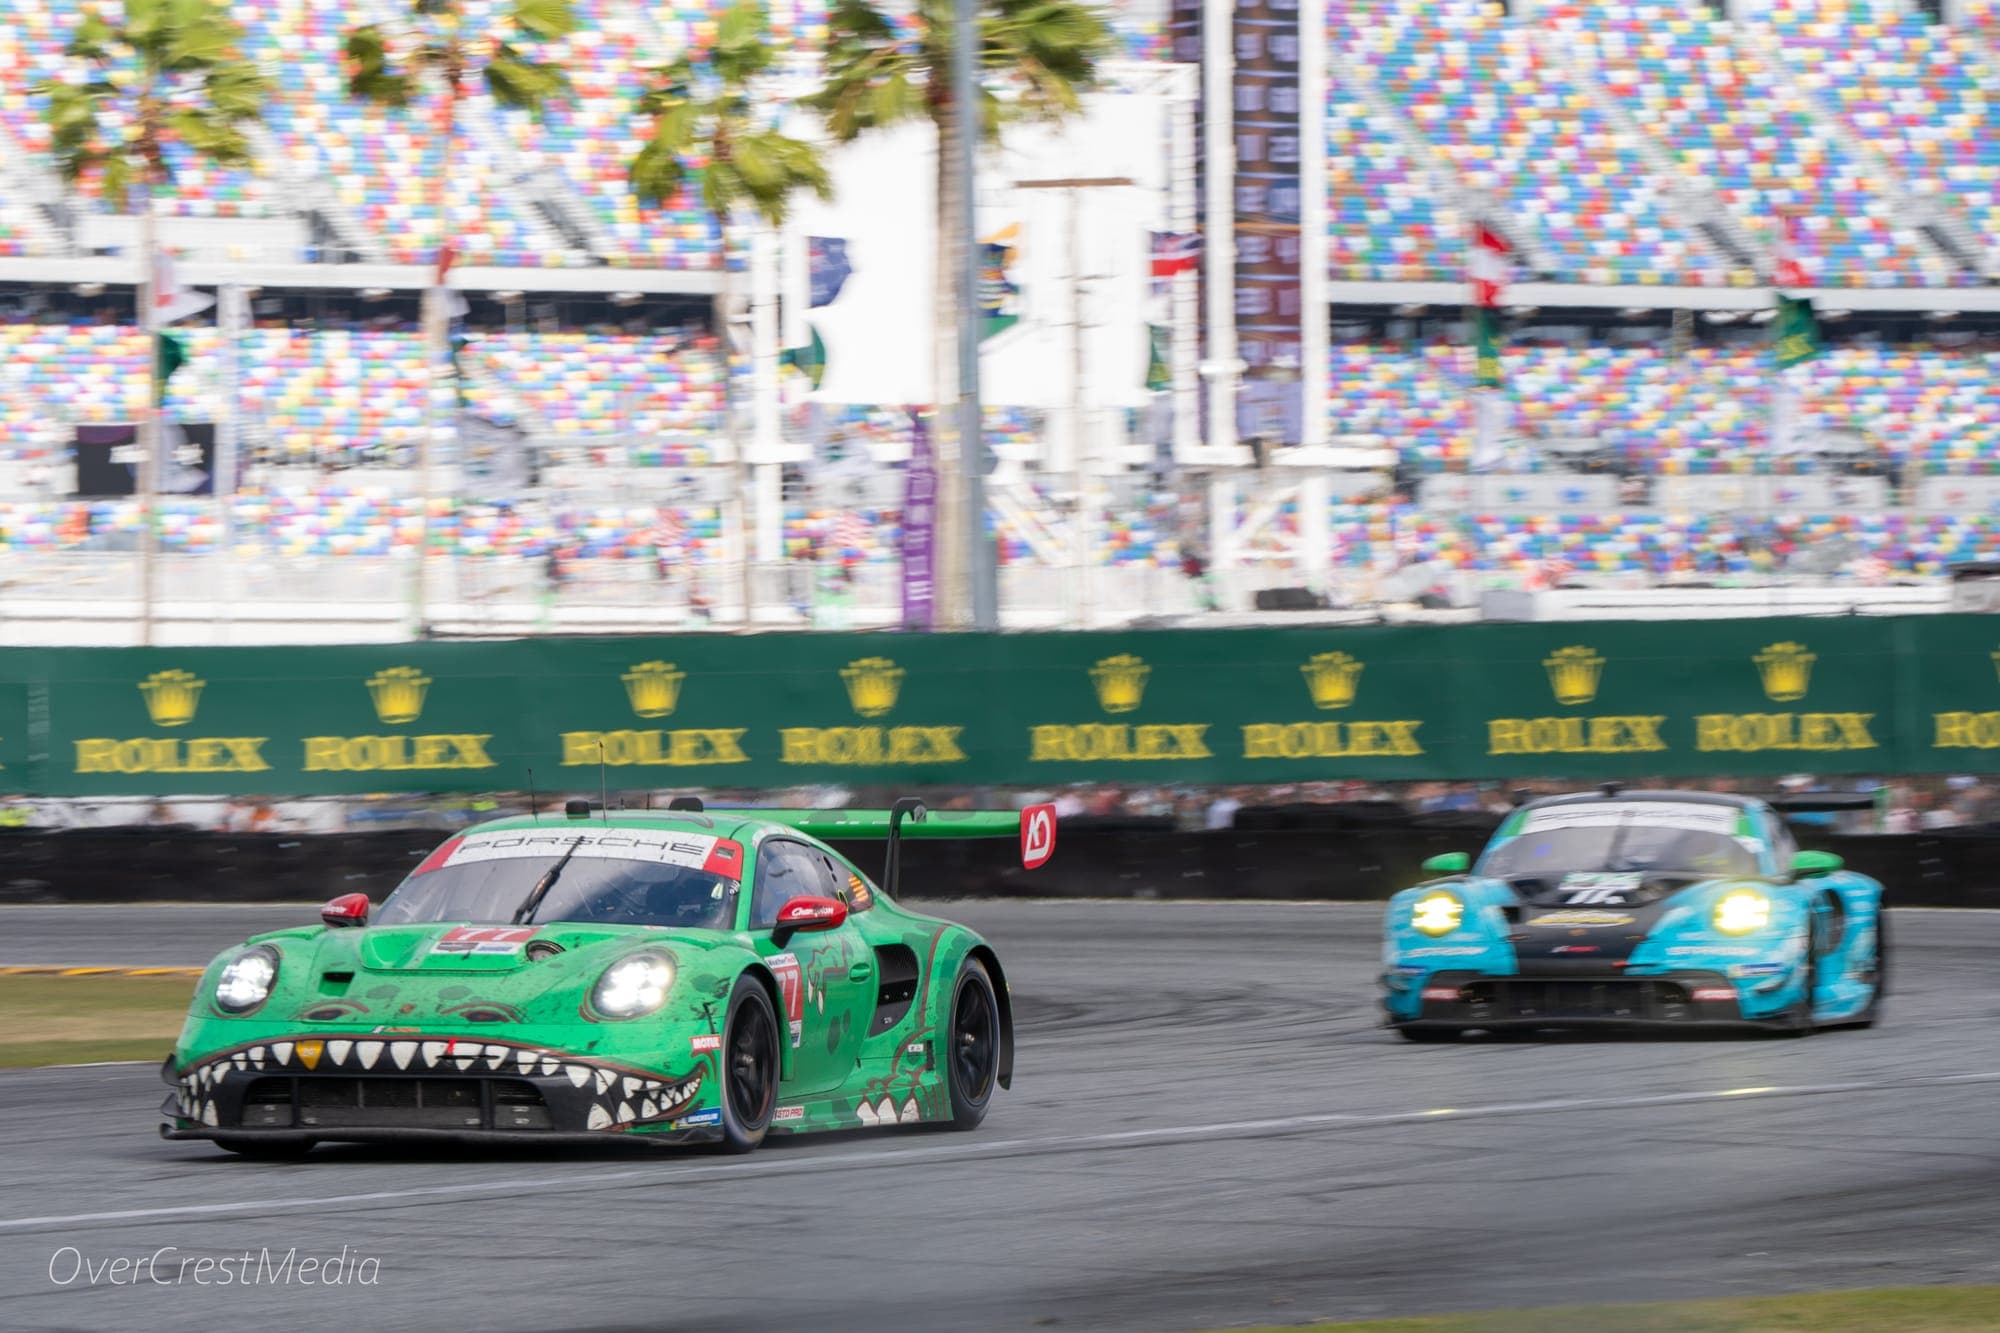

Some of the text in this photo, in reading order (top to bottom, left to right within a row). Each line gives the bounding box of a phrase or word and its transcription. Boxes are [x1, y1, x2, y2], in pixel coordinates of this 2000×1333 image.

[562, 729, 748, 767] ROLEX
[780, 725, 966, 764] ROLEX
[1031, 722, 1213, 760] ROLEX
[1242, 720, 1424, 758] ROLEX
[1488, 715, 1667, 754] ROLEX
[1696, 712, 1877, 751] ROLEX
[73, 736, 271, 773] ROLEX
[303, 733, 495, 771] ROLEX
[459, 836, 705, 856] PORSCHE
[456, 927, 532, 941] 77
[692, 1036, 720, 1049] MOTUL
